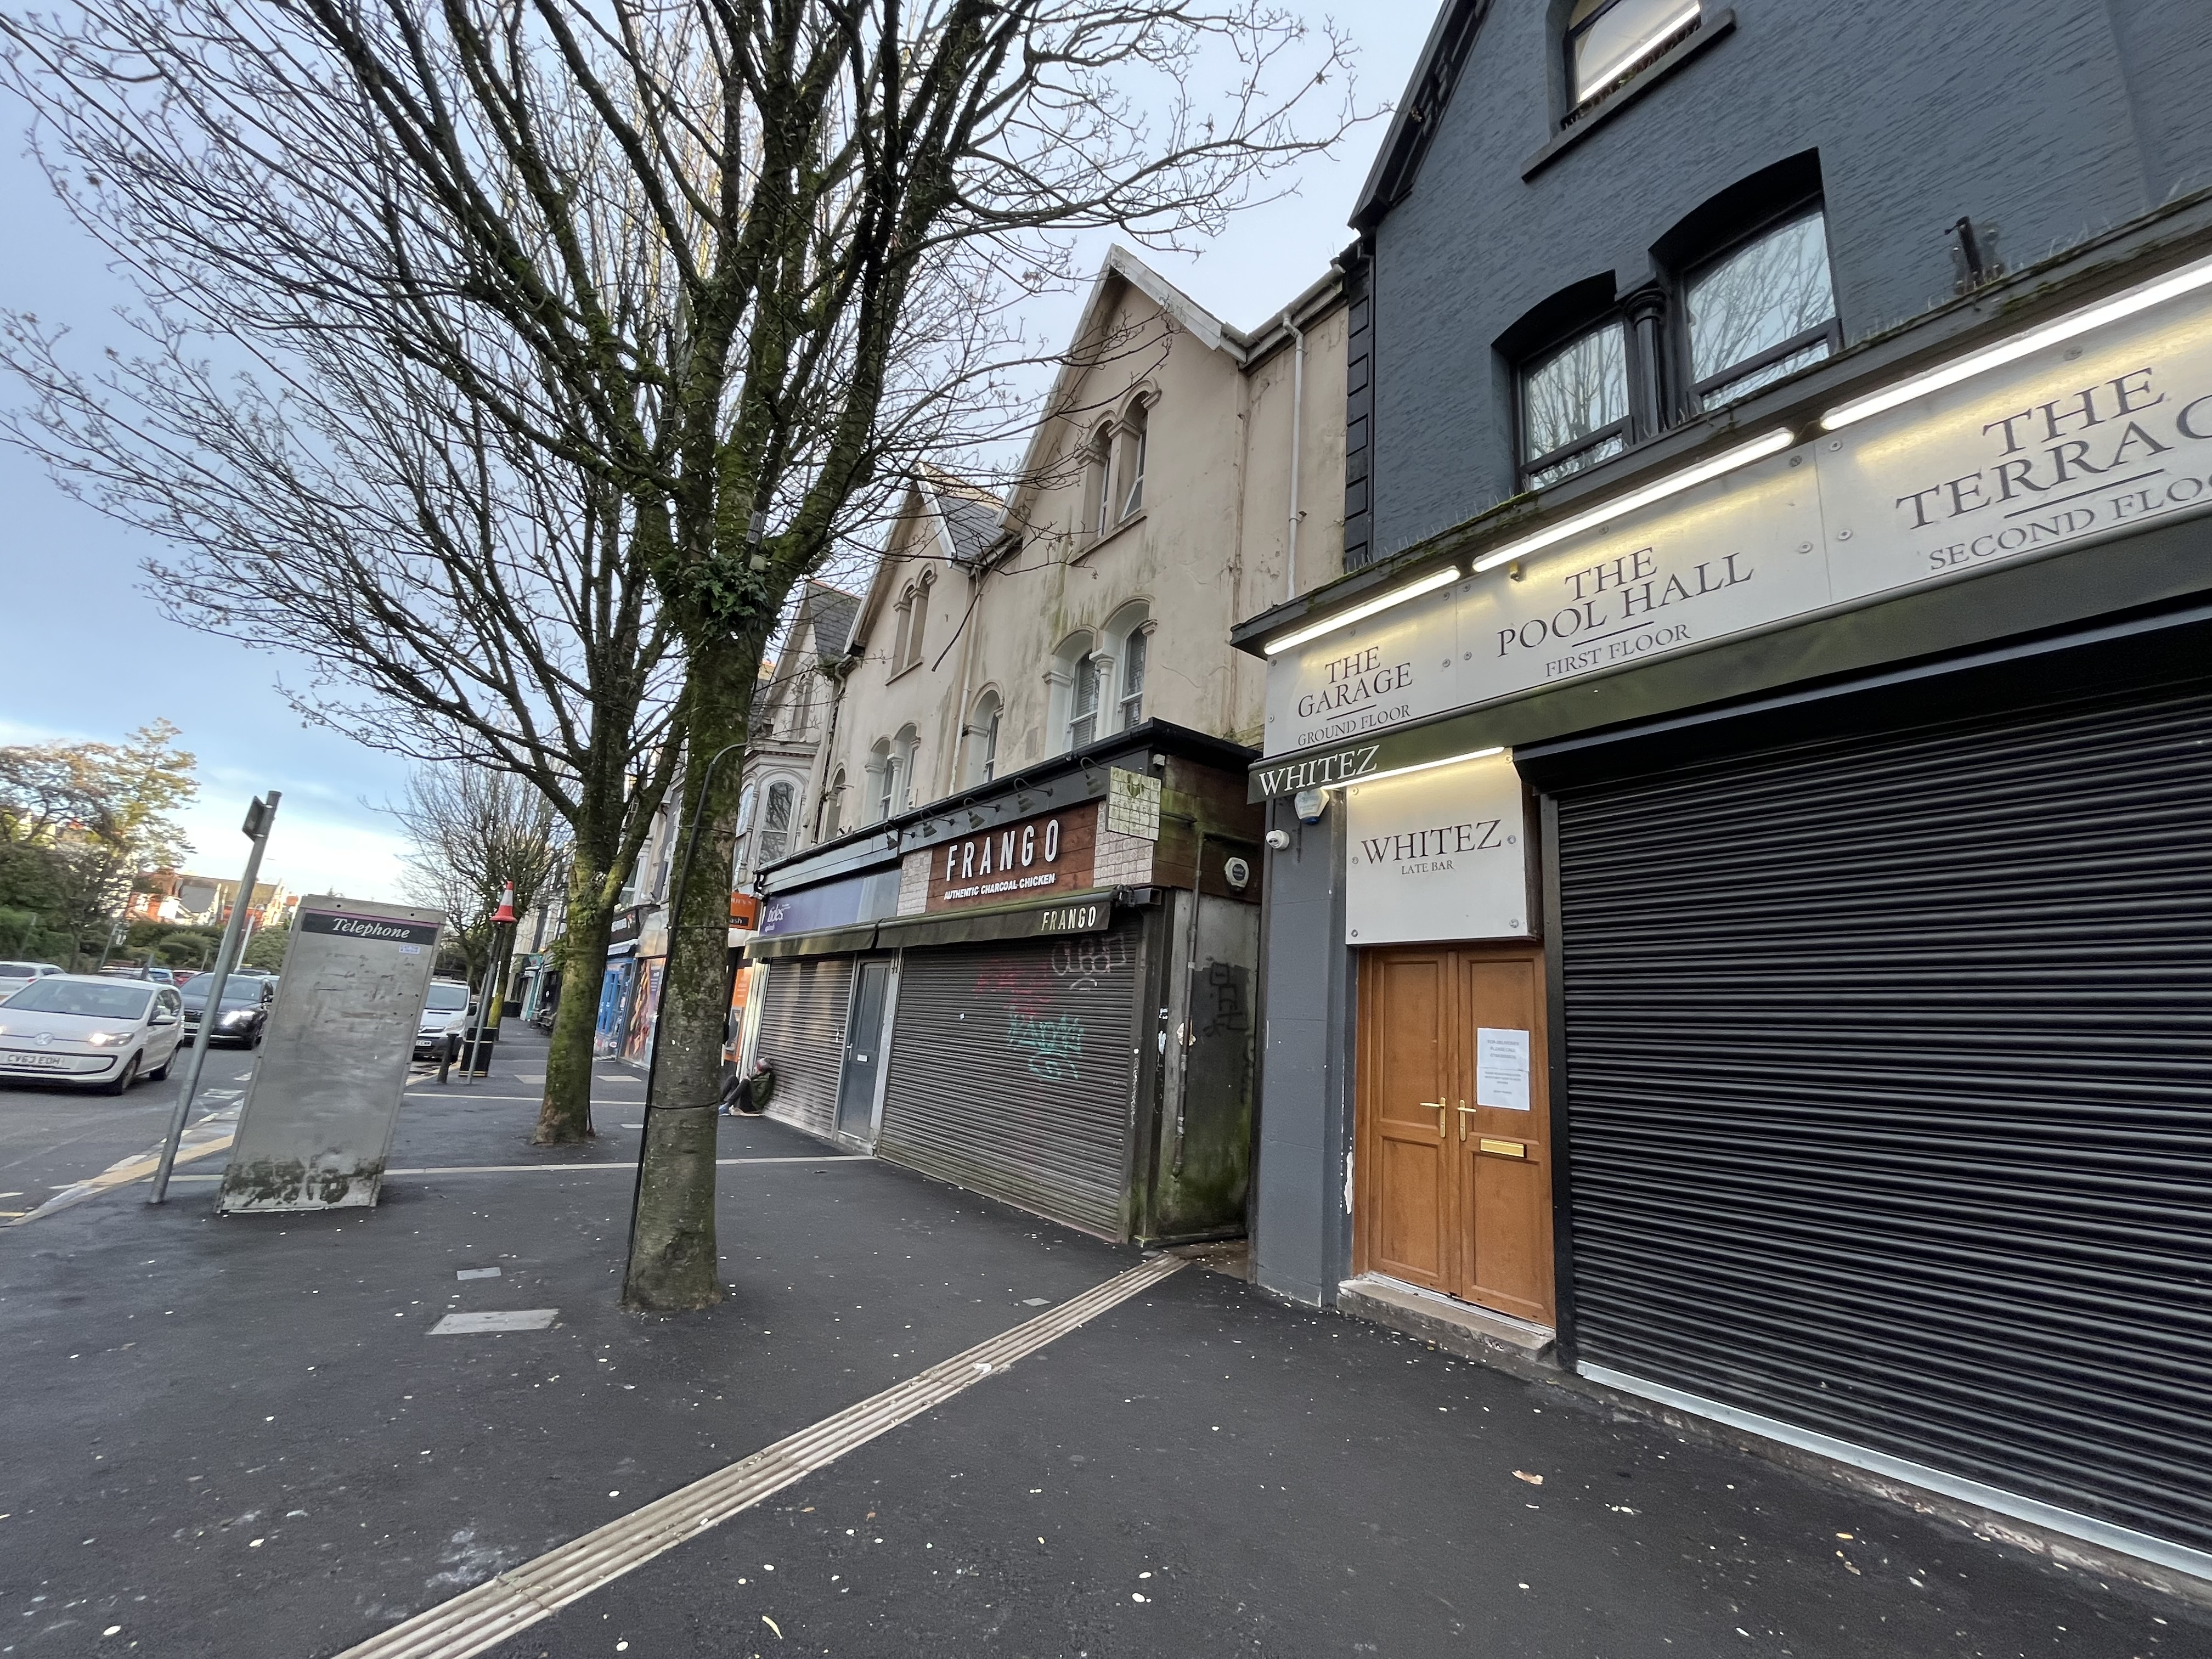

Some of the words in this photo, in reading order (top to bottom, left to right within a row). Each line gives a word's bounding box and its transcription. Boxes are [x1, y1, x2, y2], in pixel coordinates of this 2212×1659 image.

[1982, 366, 2166, 457] THE
[1929, 508, 2096, 571] SECOND
[2111, 473, 2212, 520] FLO
[1564, 546, 1658, 602] THE
[1497, 600, 1607, 658] POOL
[1621, 552, 1754, 619] HALL
[1324, 646, 1381, 685] THE
[1545, 647, 1602, 678] FIRST
[1609, 624, 1692, 660] FLOOR
[1298, 662, 1413, 718] GARAGE
[1297, 720, 1357, 747] GROUND
[1360, 704, 1412, 730] FLOOR
[1259, 744, 1381, 797] WHITEZ
[946, 819, 1060, 882] FRANGO
[1361, 819, 1502, 865] WHITEZ
[1401, 862, 1429, 874] LATE
[1431, 860, 1455, 871] BAR
[944, 885, 979, 900] AUTHENTIC
[980, 879, 1018, 895] CHARCOAL
[1018, 873, 1056, 889] CHICKEN
[333, 918, 410, 939] Telephone
[1041, 906, 1097, 931] FRANGO
